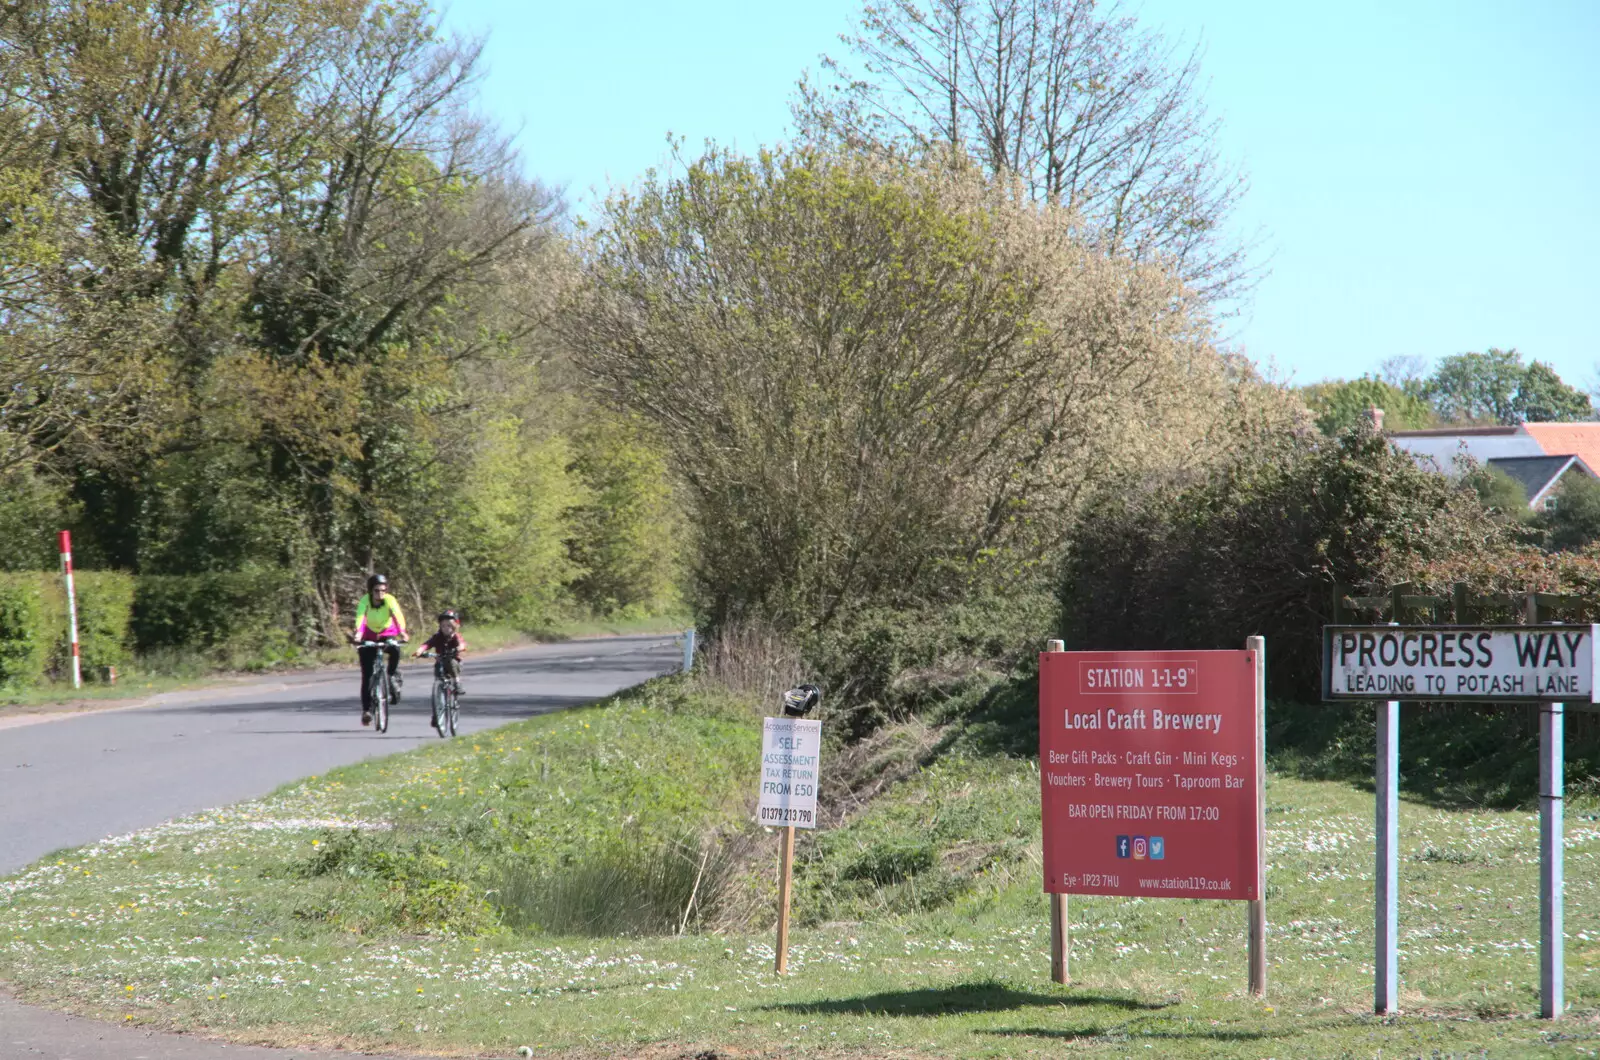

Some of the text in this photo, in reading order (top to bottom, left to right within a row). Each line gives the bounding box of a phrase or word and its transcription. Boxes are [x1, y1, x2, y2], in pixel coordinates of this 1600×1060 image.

[1340, 633, 1584, 668] PROGRESS WAY
[1087, 668, 1144, 688] STATION
[1347, 674, 1579, 693] LEADING TO POTASH LANE
[764, 722, 818, 733] Accounts Services
[1064, 709, 1222, 734] Local Craft Brewery
[779, 737, 803, 750] SELF
[764, 753, 816, 766] ASSESSMENT
[1049, 750, 1238, 768] Beer Gift Packs Craft Gin Mini Kegs
[765, 767, 813, 780] TAX RETURN
[1047, 772, 1245, 790] Vouchers Brewery Tours Taproom Bar
[763, 781, 813, 797] FROM £50
[761, 807, 812, 823] 01379 213 790
[1068, 804, 1220, 821] BAR OPEN FRIDAY FROM 17:00
[1063, 873, 1077, 887] Eye
[1102, 875, 1120, 888] 7HU
[1139, 877, 1231, 890] www.station119.co.uk
